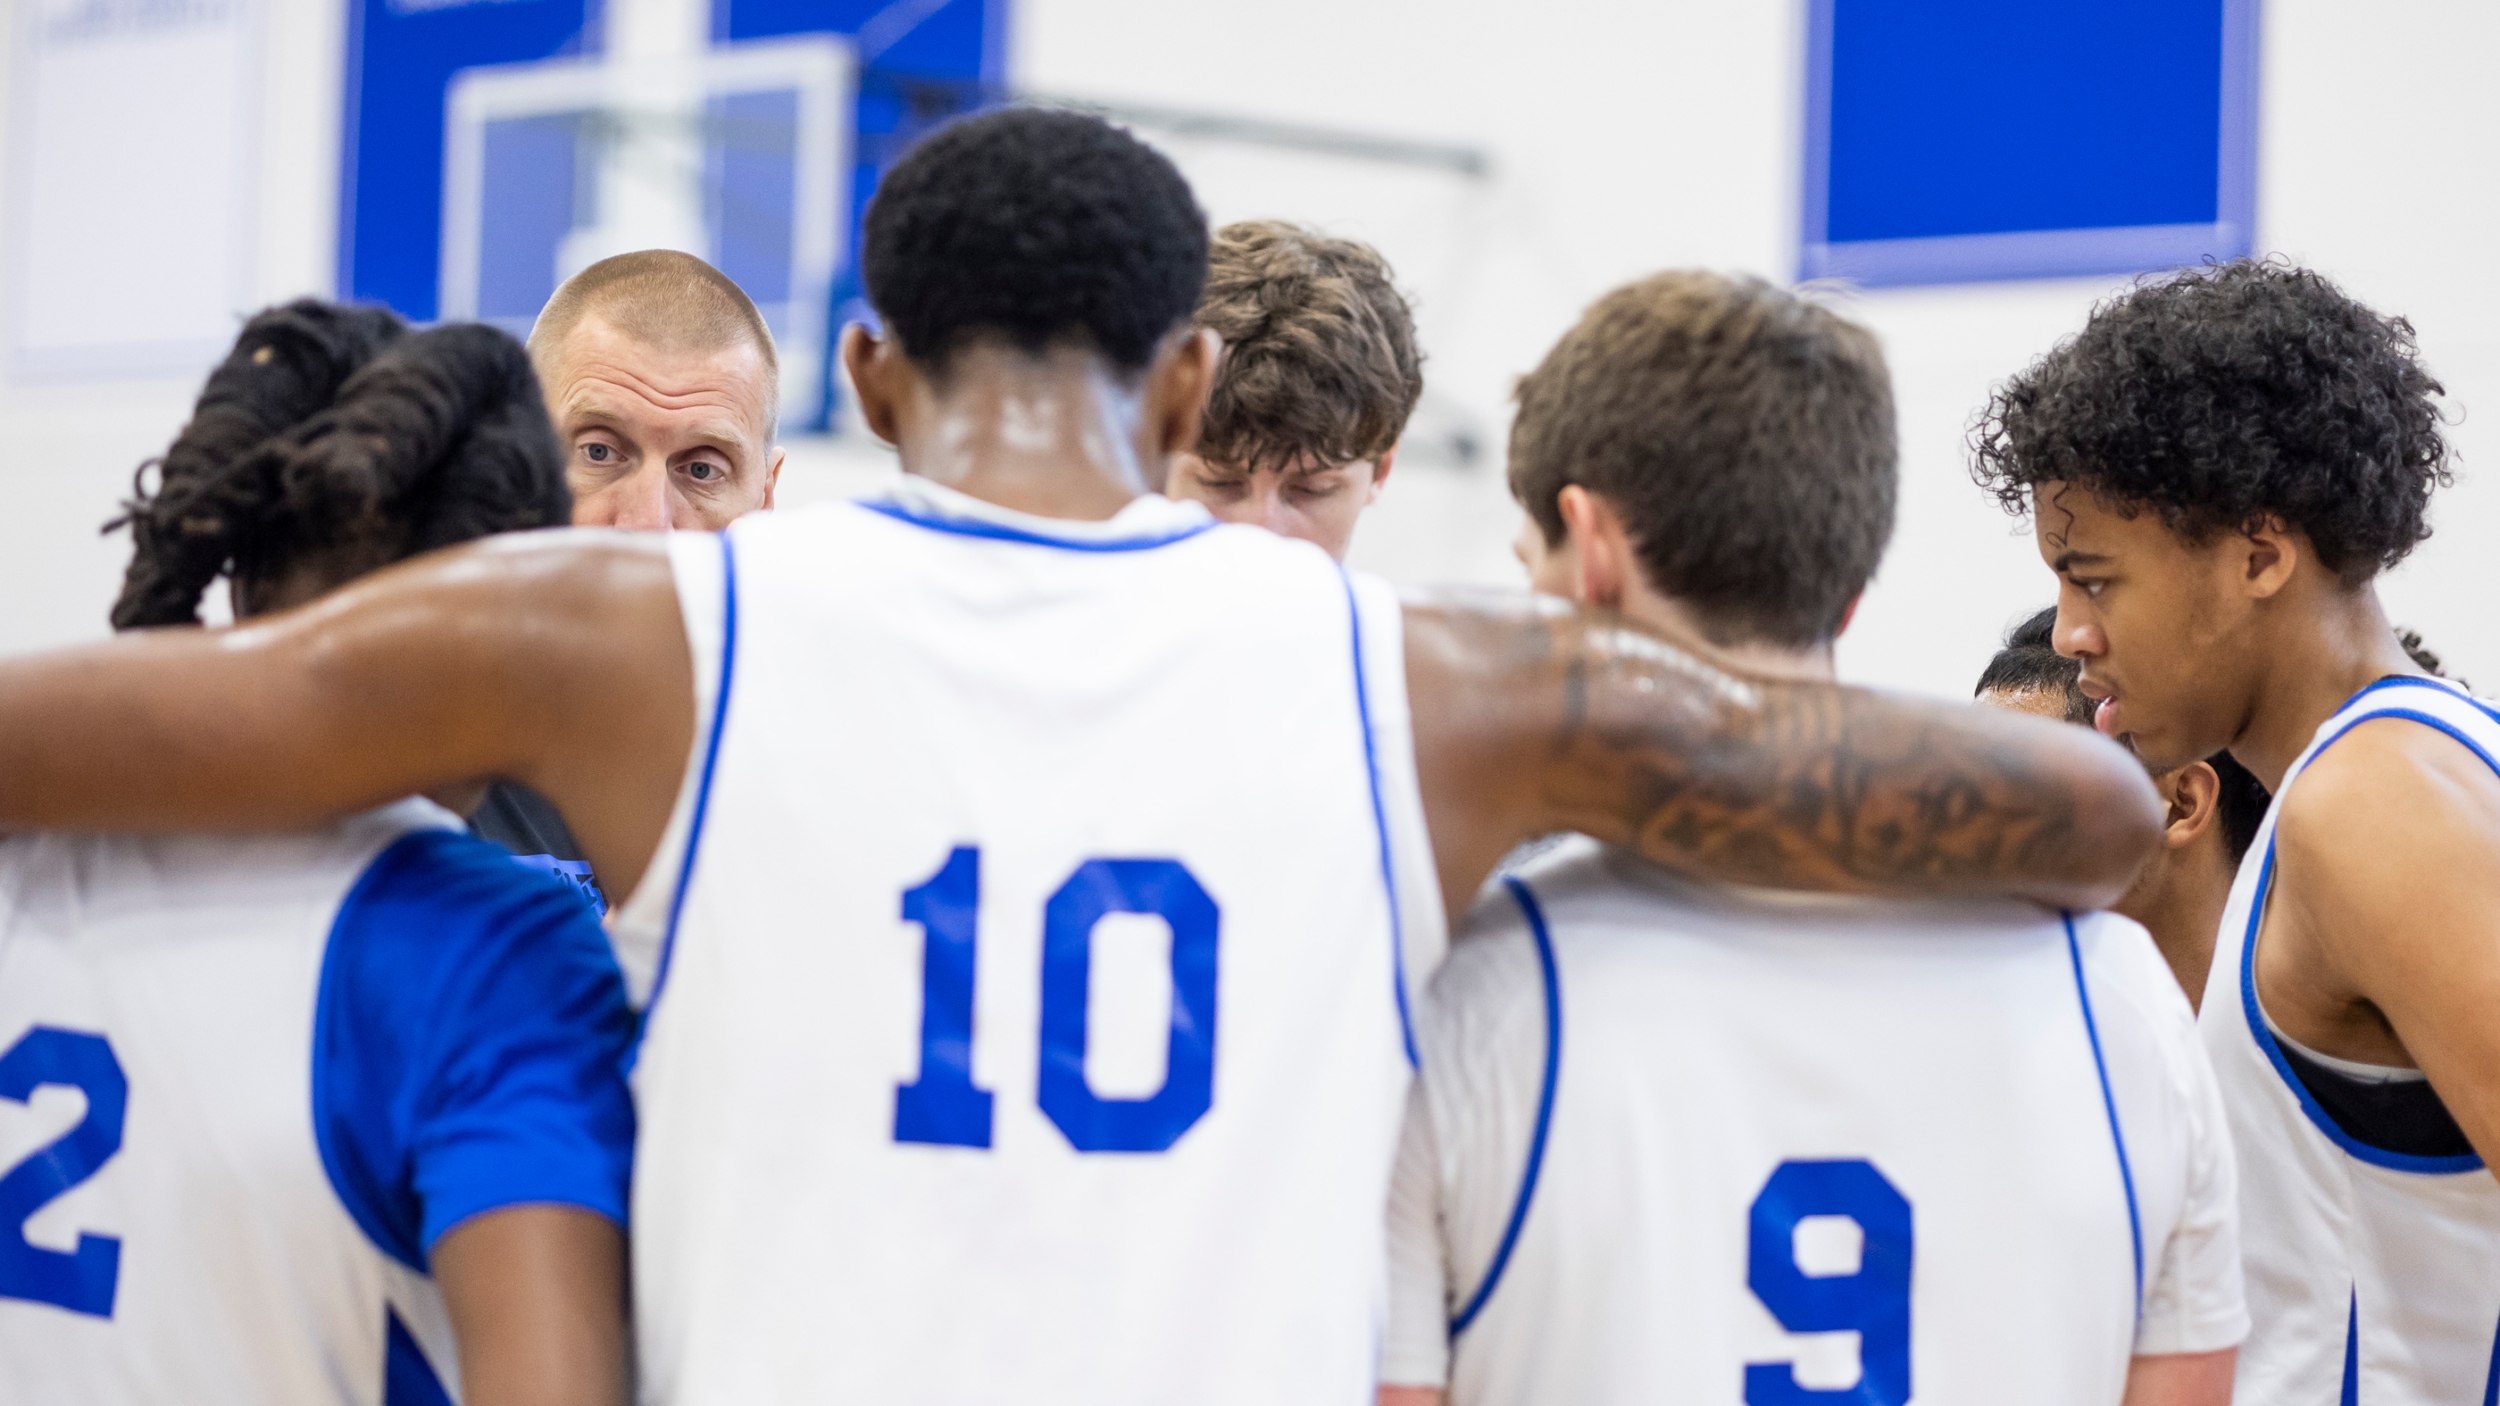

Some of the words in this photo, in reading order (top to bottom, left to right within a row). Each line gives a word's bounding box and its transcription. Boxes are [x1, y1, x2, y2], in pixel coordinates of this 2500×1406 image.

[893, 846, 1220, 1153] 10
[0, 1025, 128, 1320] 2
[1743, 1158, 1914, 1406] 9
